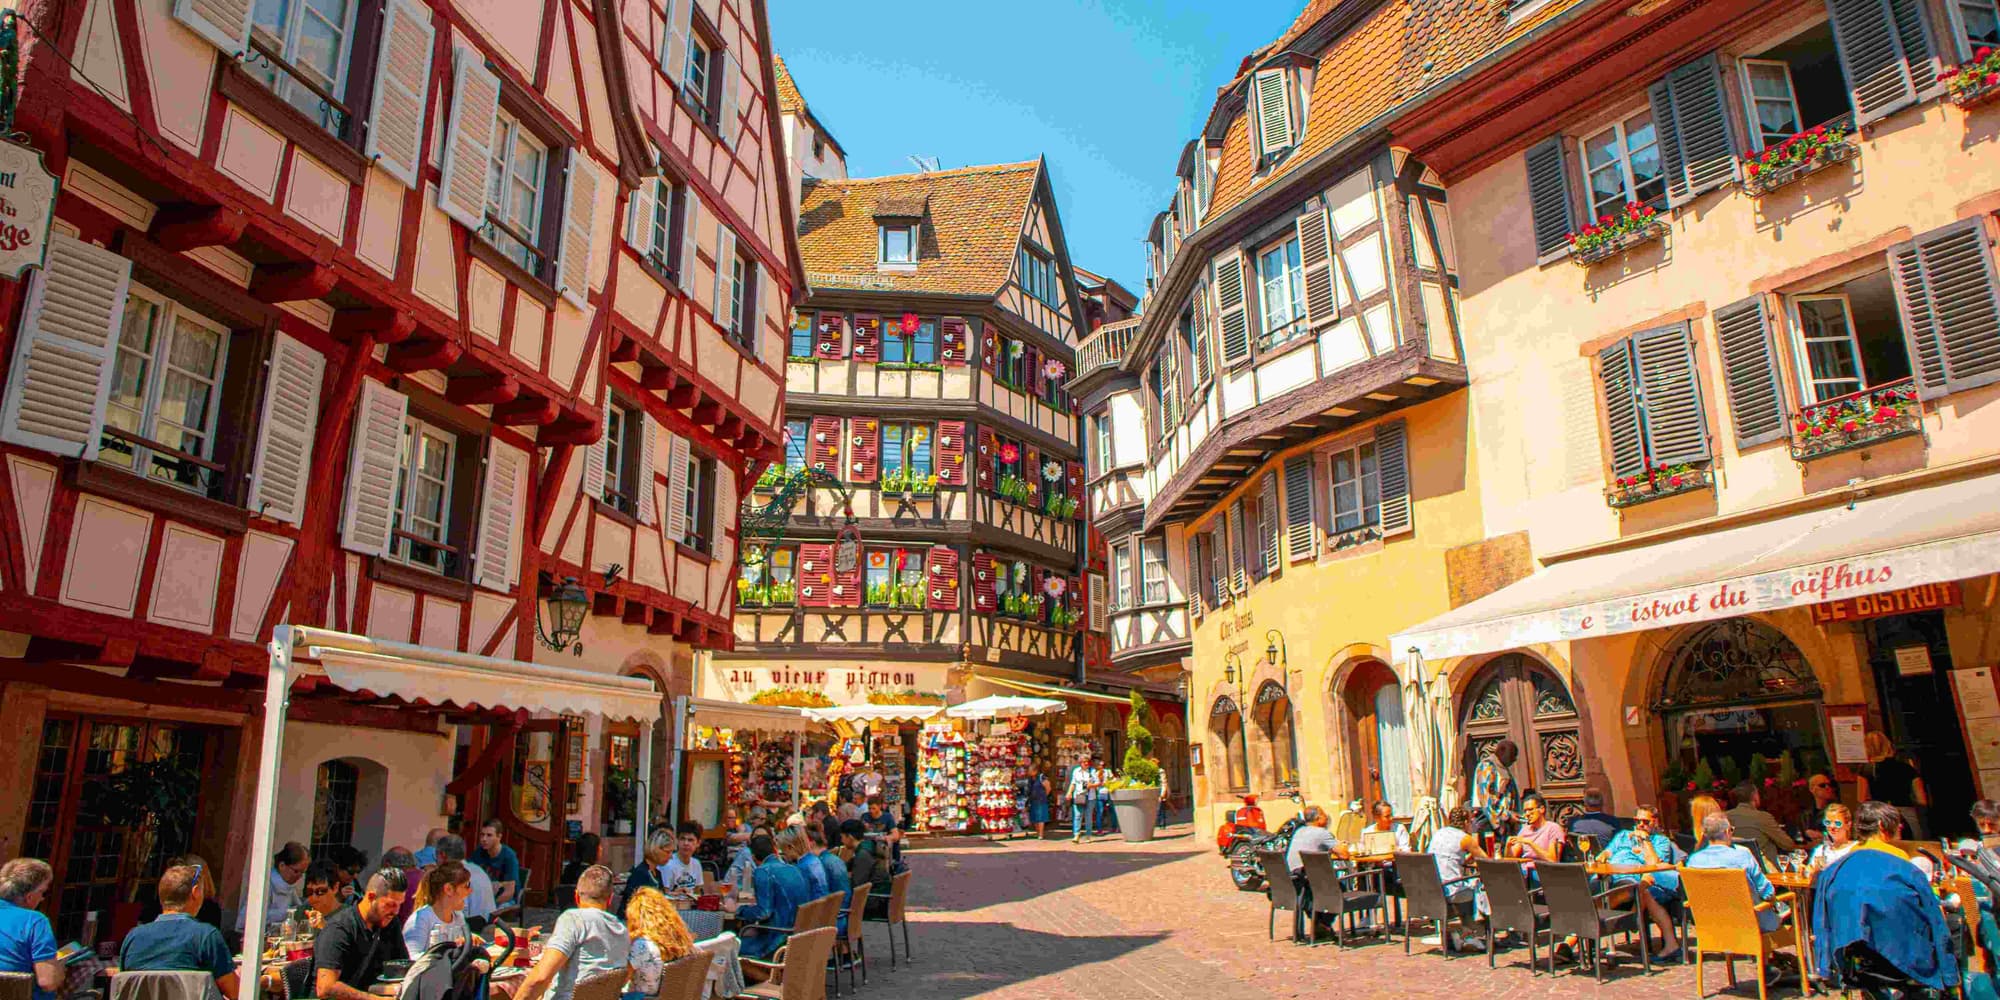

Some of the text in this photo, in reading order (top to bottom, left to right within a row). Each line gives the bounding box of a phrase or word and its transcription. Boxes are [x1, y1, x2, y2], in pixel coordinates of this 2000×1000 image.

[0, 221, 32, 251] ge
[1631, 592, 1700, 622] istrot
[1709, 584, 1749, 610] du
[1791, 563, 1892, 599] oïfhus
[730, 665, 915, 690] au vieux pignon
